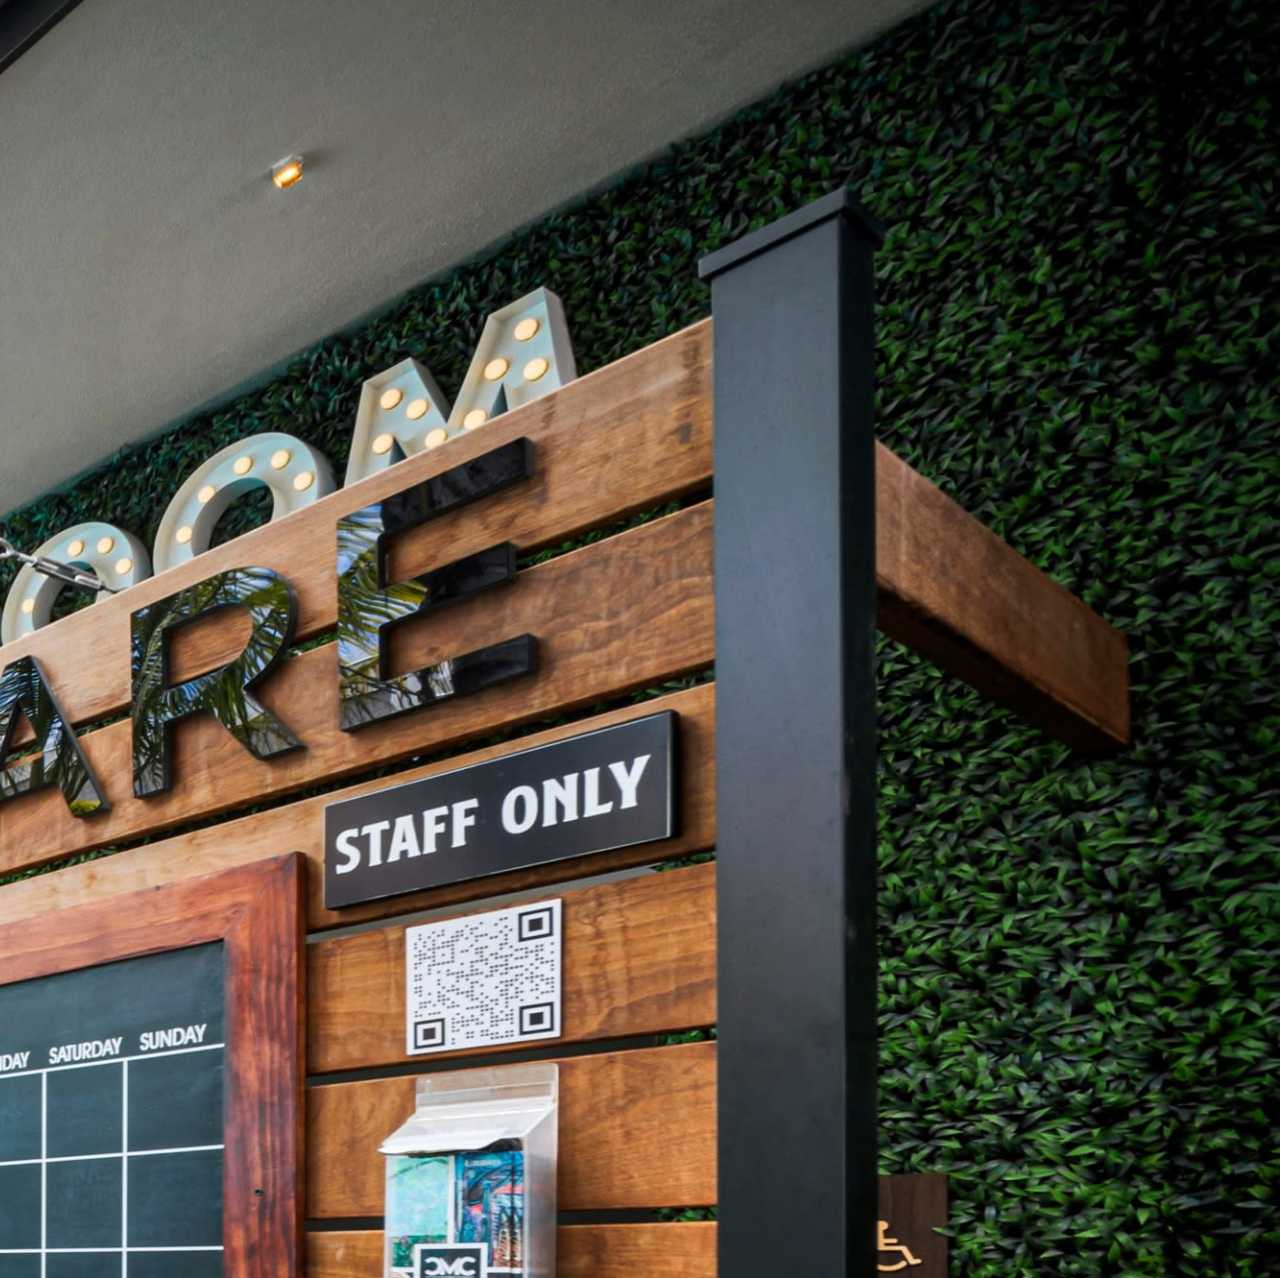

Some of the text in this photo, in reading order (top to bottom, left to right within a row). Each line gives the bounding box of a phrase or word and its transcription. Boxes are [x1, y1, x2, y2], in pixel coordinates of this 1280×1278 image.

[335, 753, 652, 875] STAFF ONLY
[48, 1036, 123, 1065] SATURDAY
[139, 1023, 207, 1052] SUNDAY
